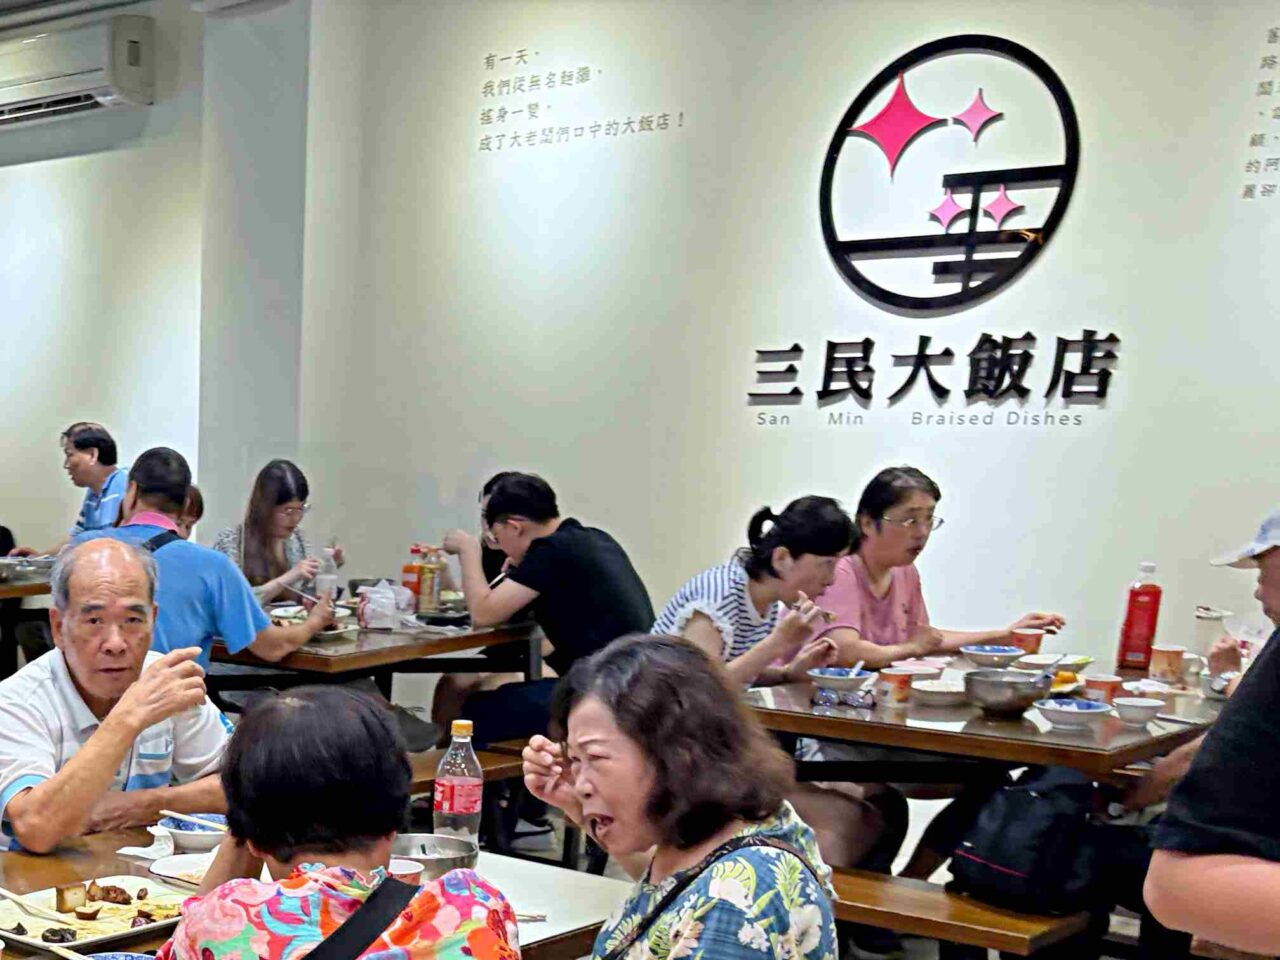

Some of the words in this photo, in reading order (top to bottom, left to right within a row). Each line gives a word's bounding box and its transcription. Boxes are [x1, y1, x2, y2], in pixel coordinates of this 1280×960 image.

[747, 329, 1121, 406] 三民大飯店
[756, 411, 791, 426] San
[827, 411, 865, 426] Min
[910, 410, 995, 426] Braised
[1006, 410, 1084, 426] Dishes
